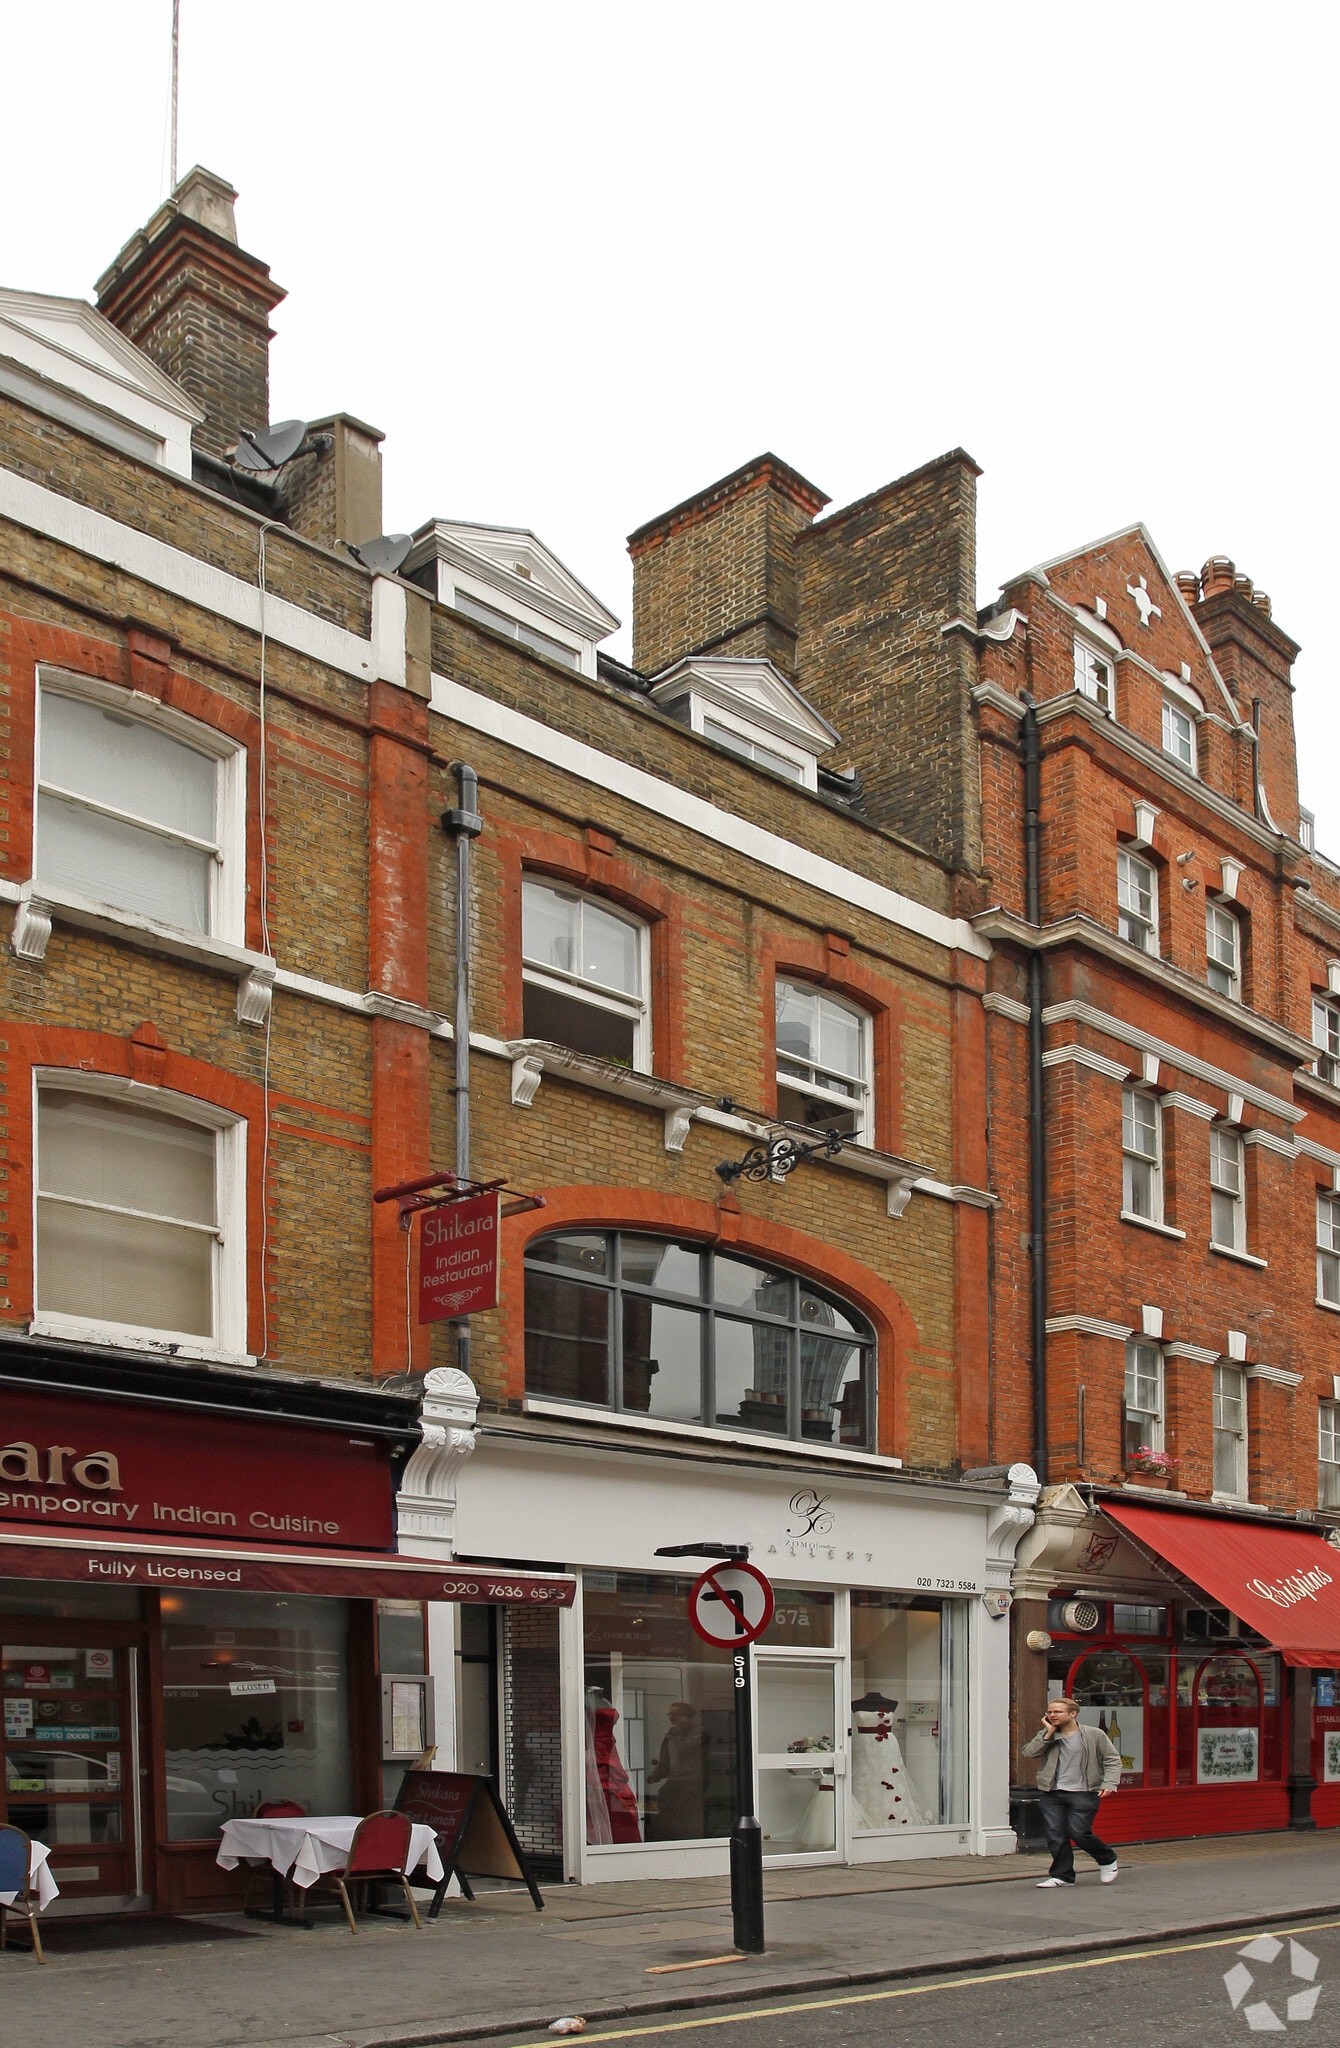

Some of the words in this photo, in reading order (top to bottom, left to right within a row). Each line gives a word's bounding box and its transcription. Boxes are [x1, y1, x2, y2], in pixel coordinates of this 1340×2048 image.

[424, 1214, 494, 1247] Shikara
[436, 1249, 480, 1270] Indian
[423, 1260, 494, 1288] Restaurant
[0, 1441, 124, 1491] ara
[153, 1502, 236, 1526] Indian
[249, 1511, 340, 1535] Cuisine
[88, 1559, 137, 1577] Fully
[147, 1563, 241, 1582] Licensed
[443, 1582, 479, 1594] 020
[487, 1584, 523, 1598] 7636
[917, 1577, 932, 1587] 020
[936, 1578, 955, 1589] 7323
[958, 1581, 976, 1590] 5584
[1246, 1565, 1333, 1608] Crispins
[775, 1608, 811, 1626] 67a
[734, 1656, 746, 1688] S19
[236, 1683, 270, 1692] CLOSED
[36, 1731, 63, 1739] 2010
[416, 1782, 460, 1801] Shikara
[423, 1812, 456, 1826] Lunch
